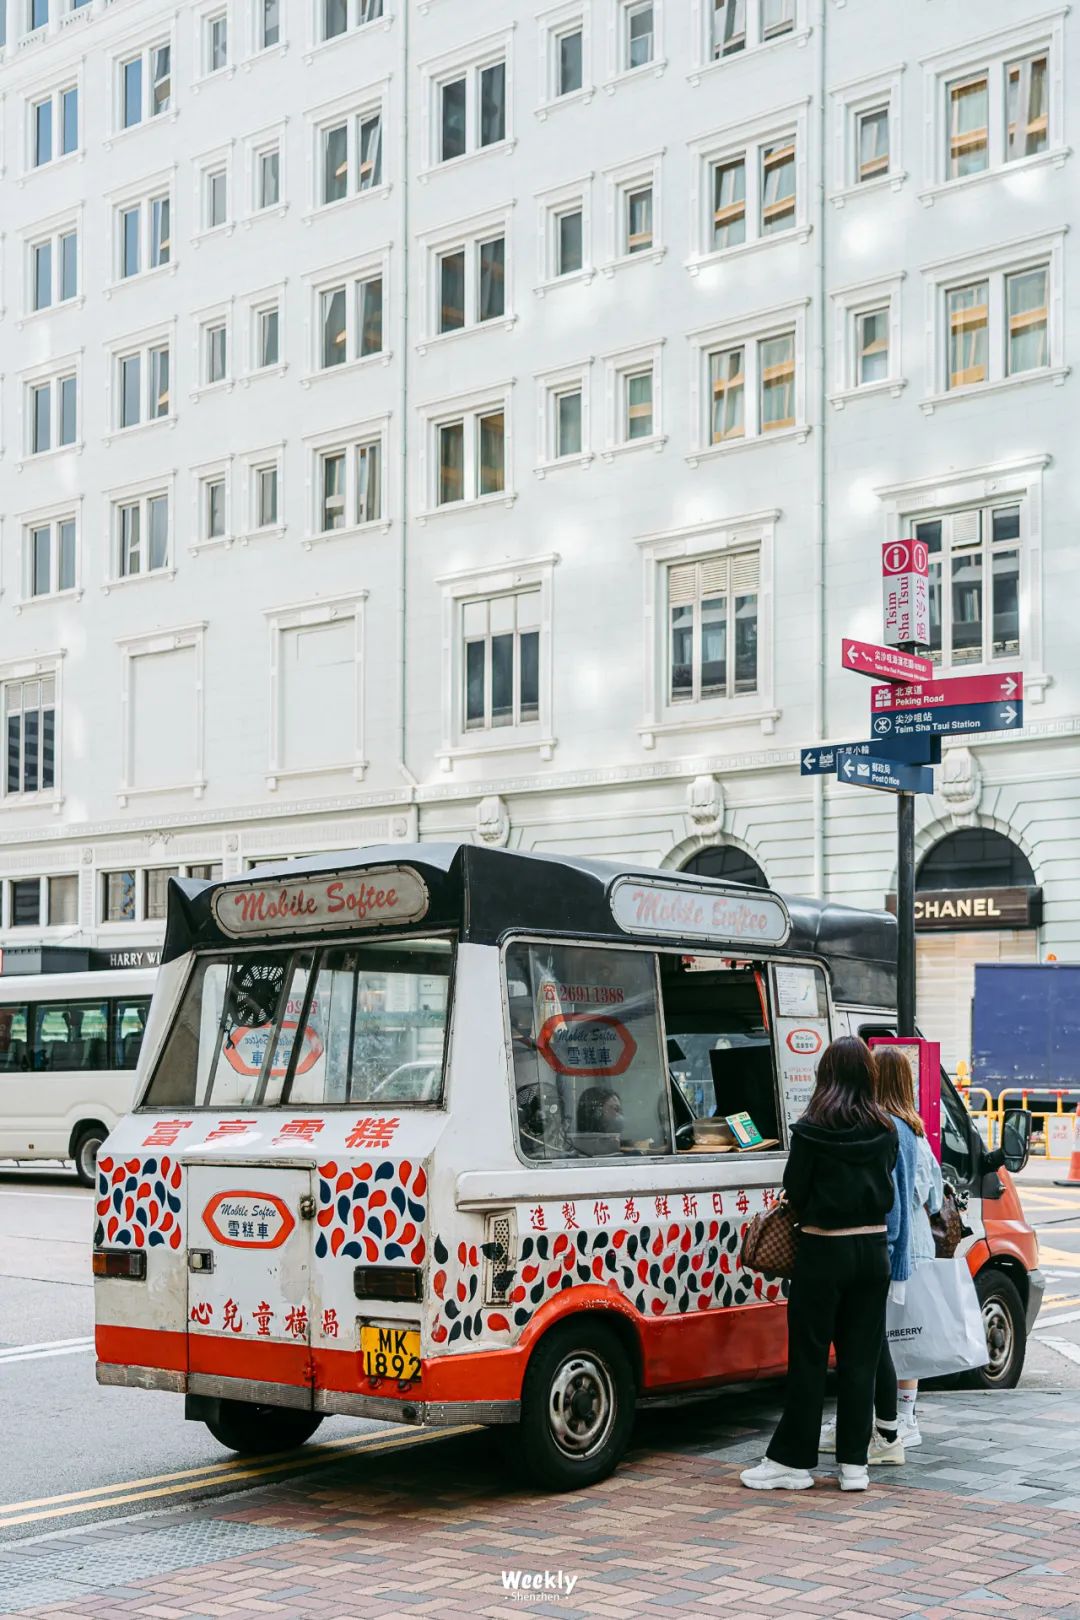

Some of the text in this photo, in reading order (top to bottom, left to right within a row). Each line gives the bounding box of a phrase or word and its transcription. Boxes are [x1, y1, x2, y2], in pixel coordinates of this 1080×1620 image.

[886, 592, 897, 628] Tsim
[897, 576, 909, 640] Sha Tsui
[895, 685, 923, 697] 北京道
[895, 694, 944, 706] Peking Road
[895, 712, 933, 724] 尖沙咀站
[895, 720, 981, 734] Tsim Sha Tsui Station
[871, 762, 891, 773] 郵政局
[234, 882, 399, 922] Mobile Softee
[913, 898, 1001, 919] CHANEL
[110, 951, 162, 967] HARRY WI
[560, 984, 624, 1003] 2691 1388
[558, 1028, 617, 1045] Mobile Softee
[567, 1046, 612, 1065] 雪糕車
[220, 1203, 277, 1220] Mobile Softee
[228, 1220, 269, 1239] 雪糕車
[379, 1328, 408, 1355] MK
[367, 1351, 422, 1381] 1892
